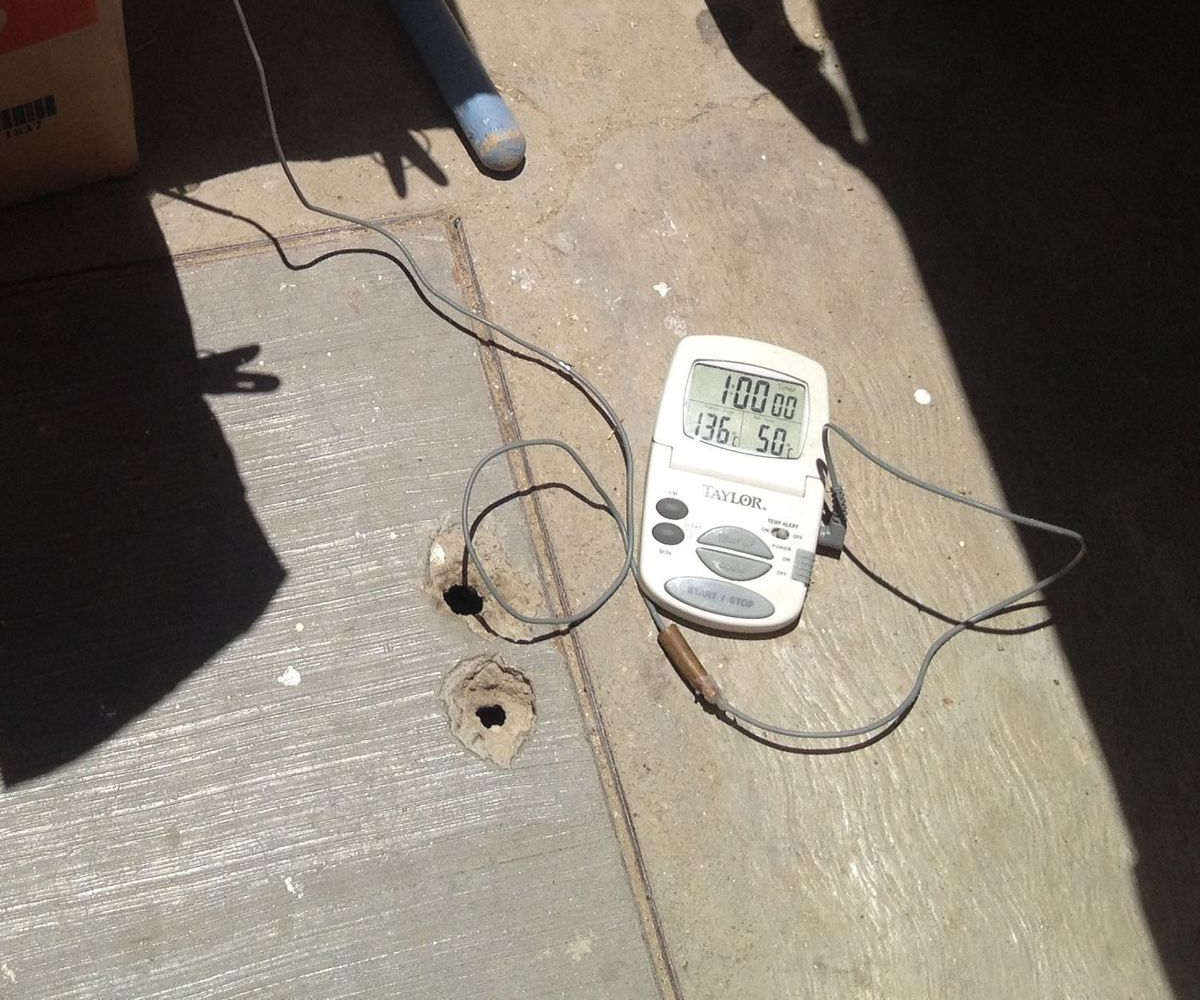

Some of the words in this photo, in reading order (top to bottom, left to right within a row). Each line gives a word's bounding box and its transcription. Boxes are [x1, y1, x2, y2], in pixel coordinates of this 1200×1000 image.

[702, 483, 762, 511] TAYLOR
[687, 586, 717, 600] START
[729, 594, 755, 609] STOP
